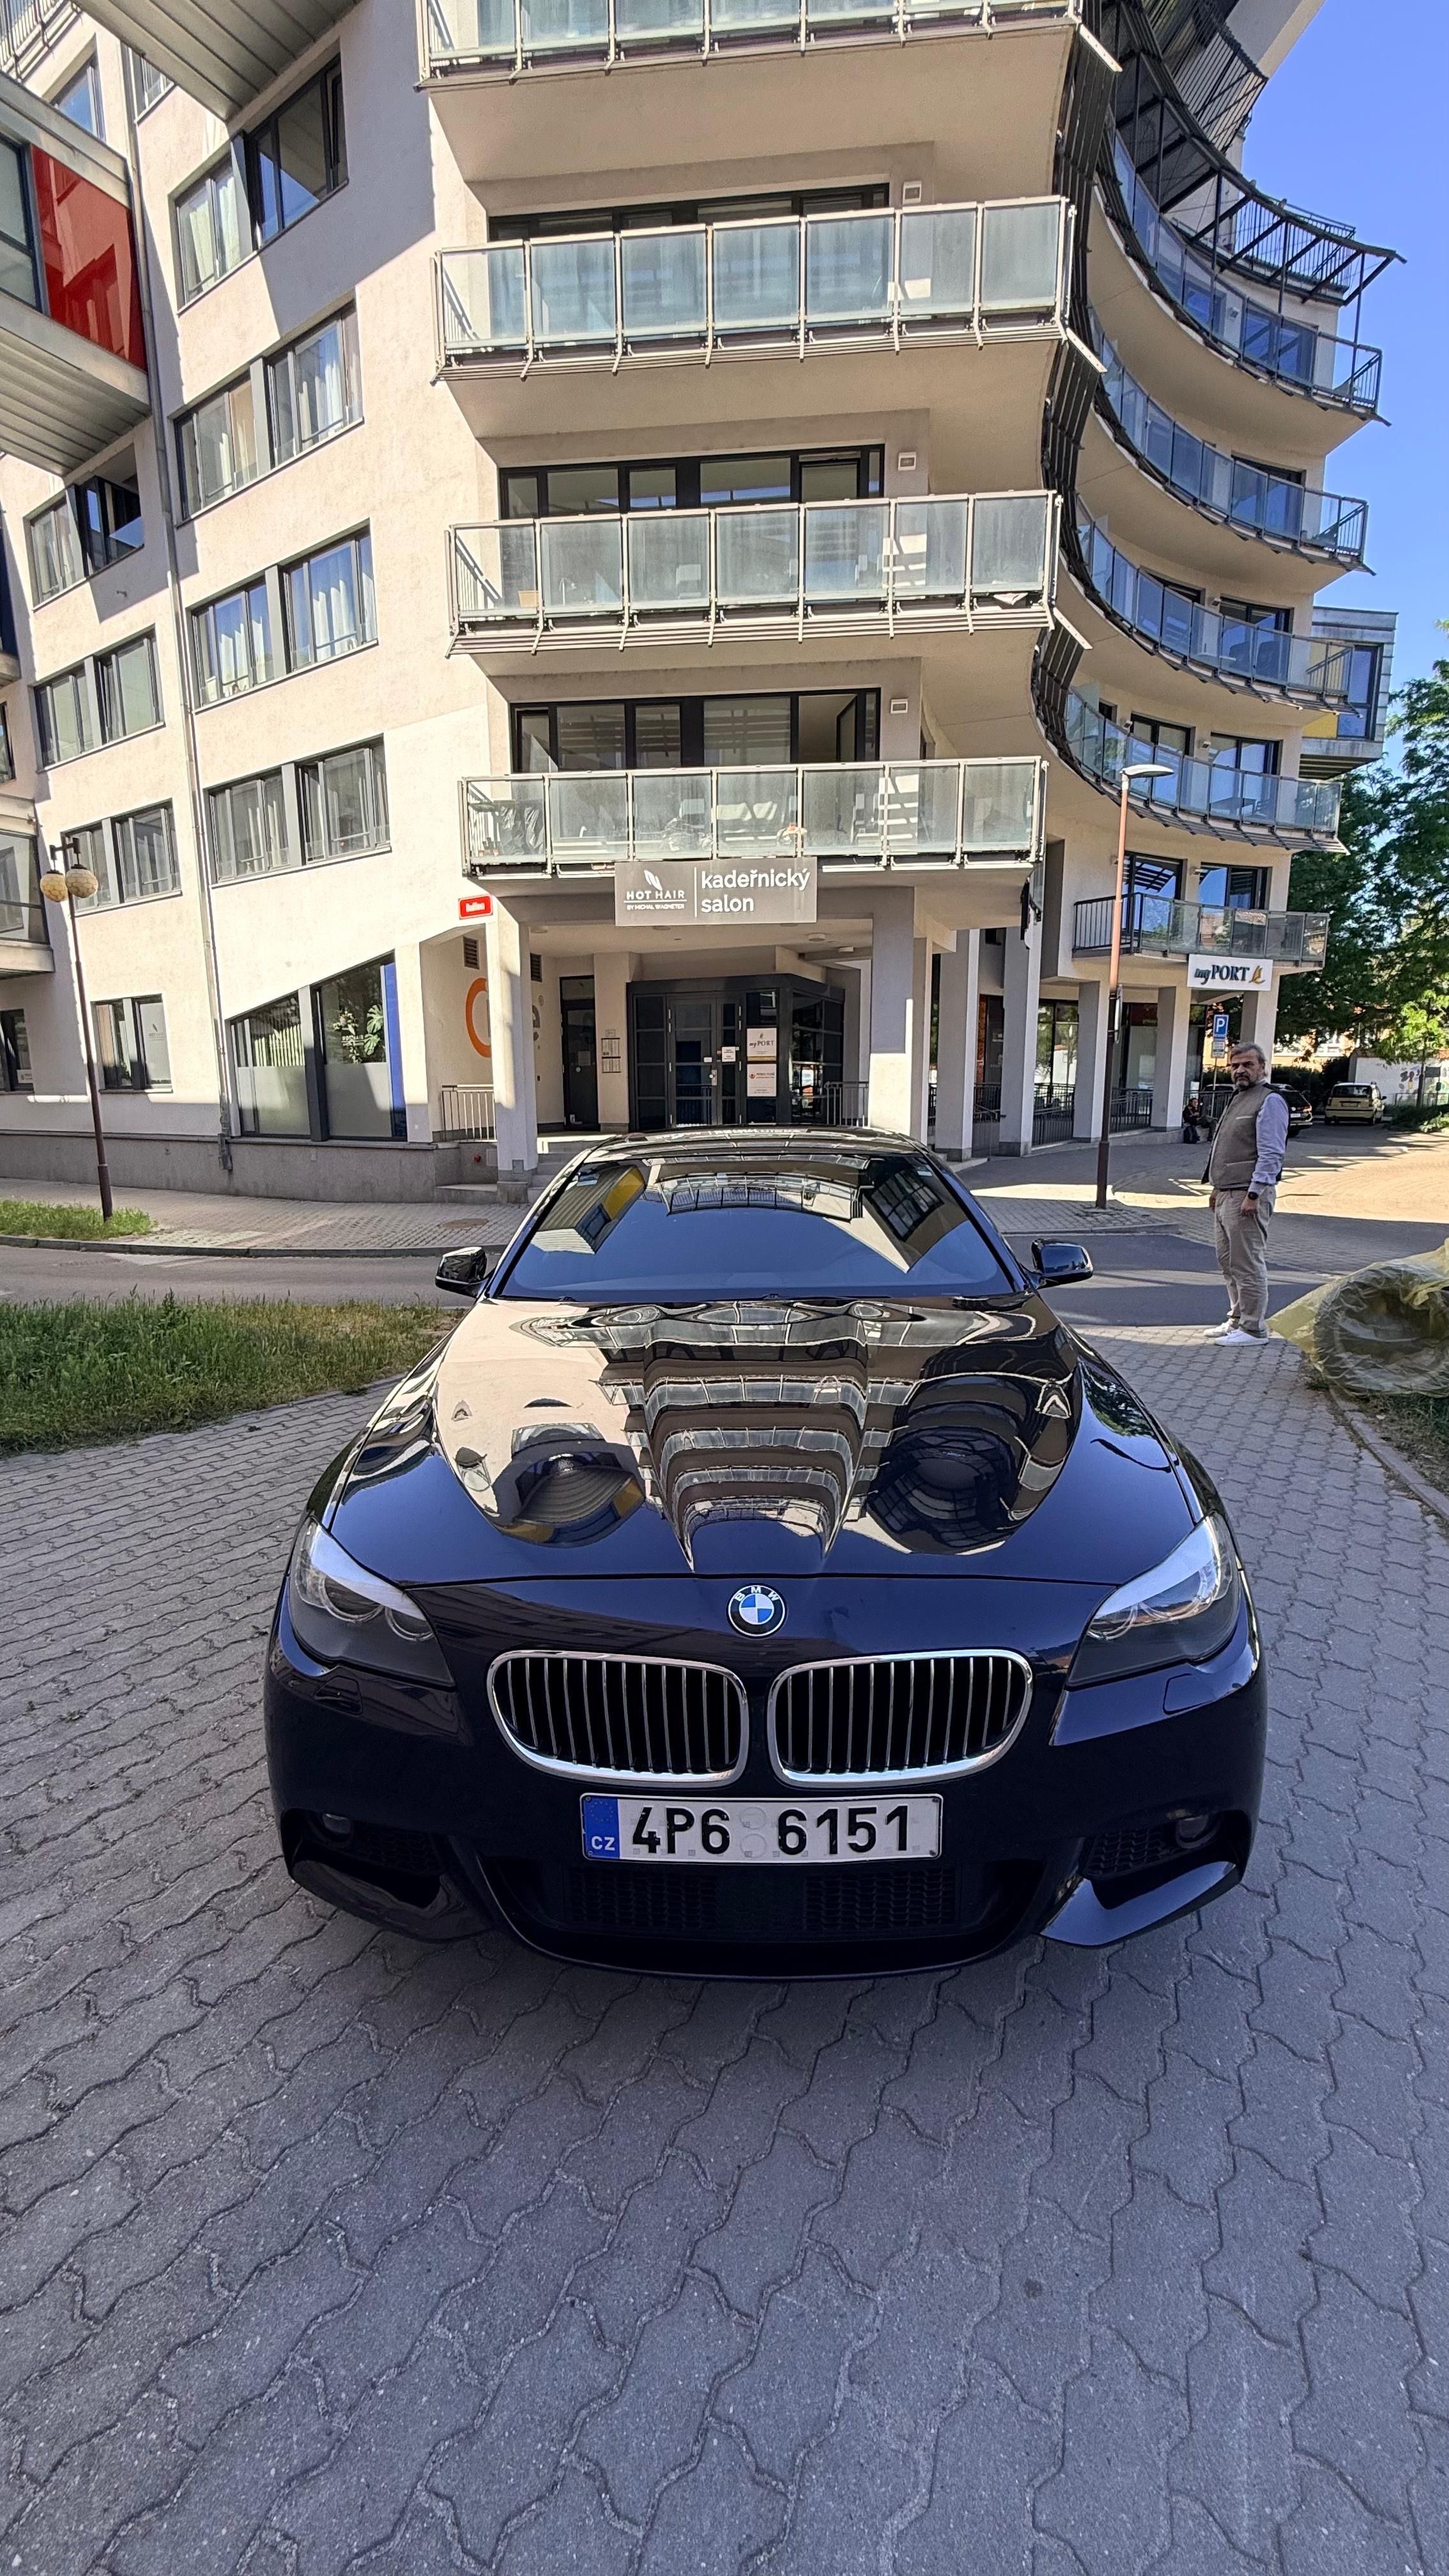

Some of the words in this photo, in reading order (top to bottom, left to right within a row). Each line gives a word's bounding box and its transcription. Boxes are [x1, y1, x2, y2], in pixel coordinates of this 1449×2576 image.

[702, 868, 811, 891] kadeřnický
[626, 891, 652, 900] HOT
[656, 890, 685, 900] HAIR
[701, 894, 754, 913] salon
[1194, 965, 1250, 985] myPORT
[1216, 1018, 1225, 1032] P
[734, 1586, 780, 1602] BMW
[632, 1806, 730, 1855] 4P6
[778, 1805, 908, 1855] 6151
[591, 1836, 615, 1851] CZ
